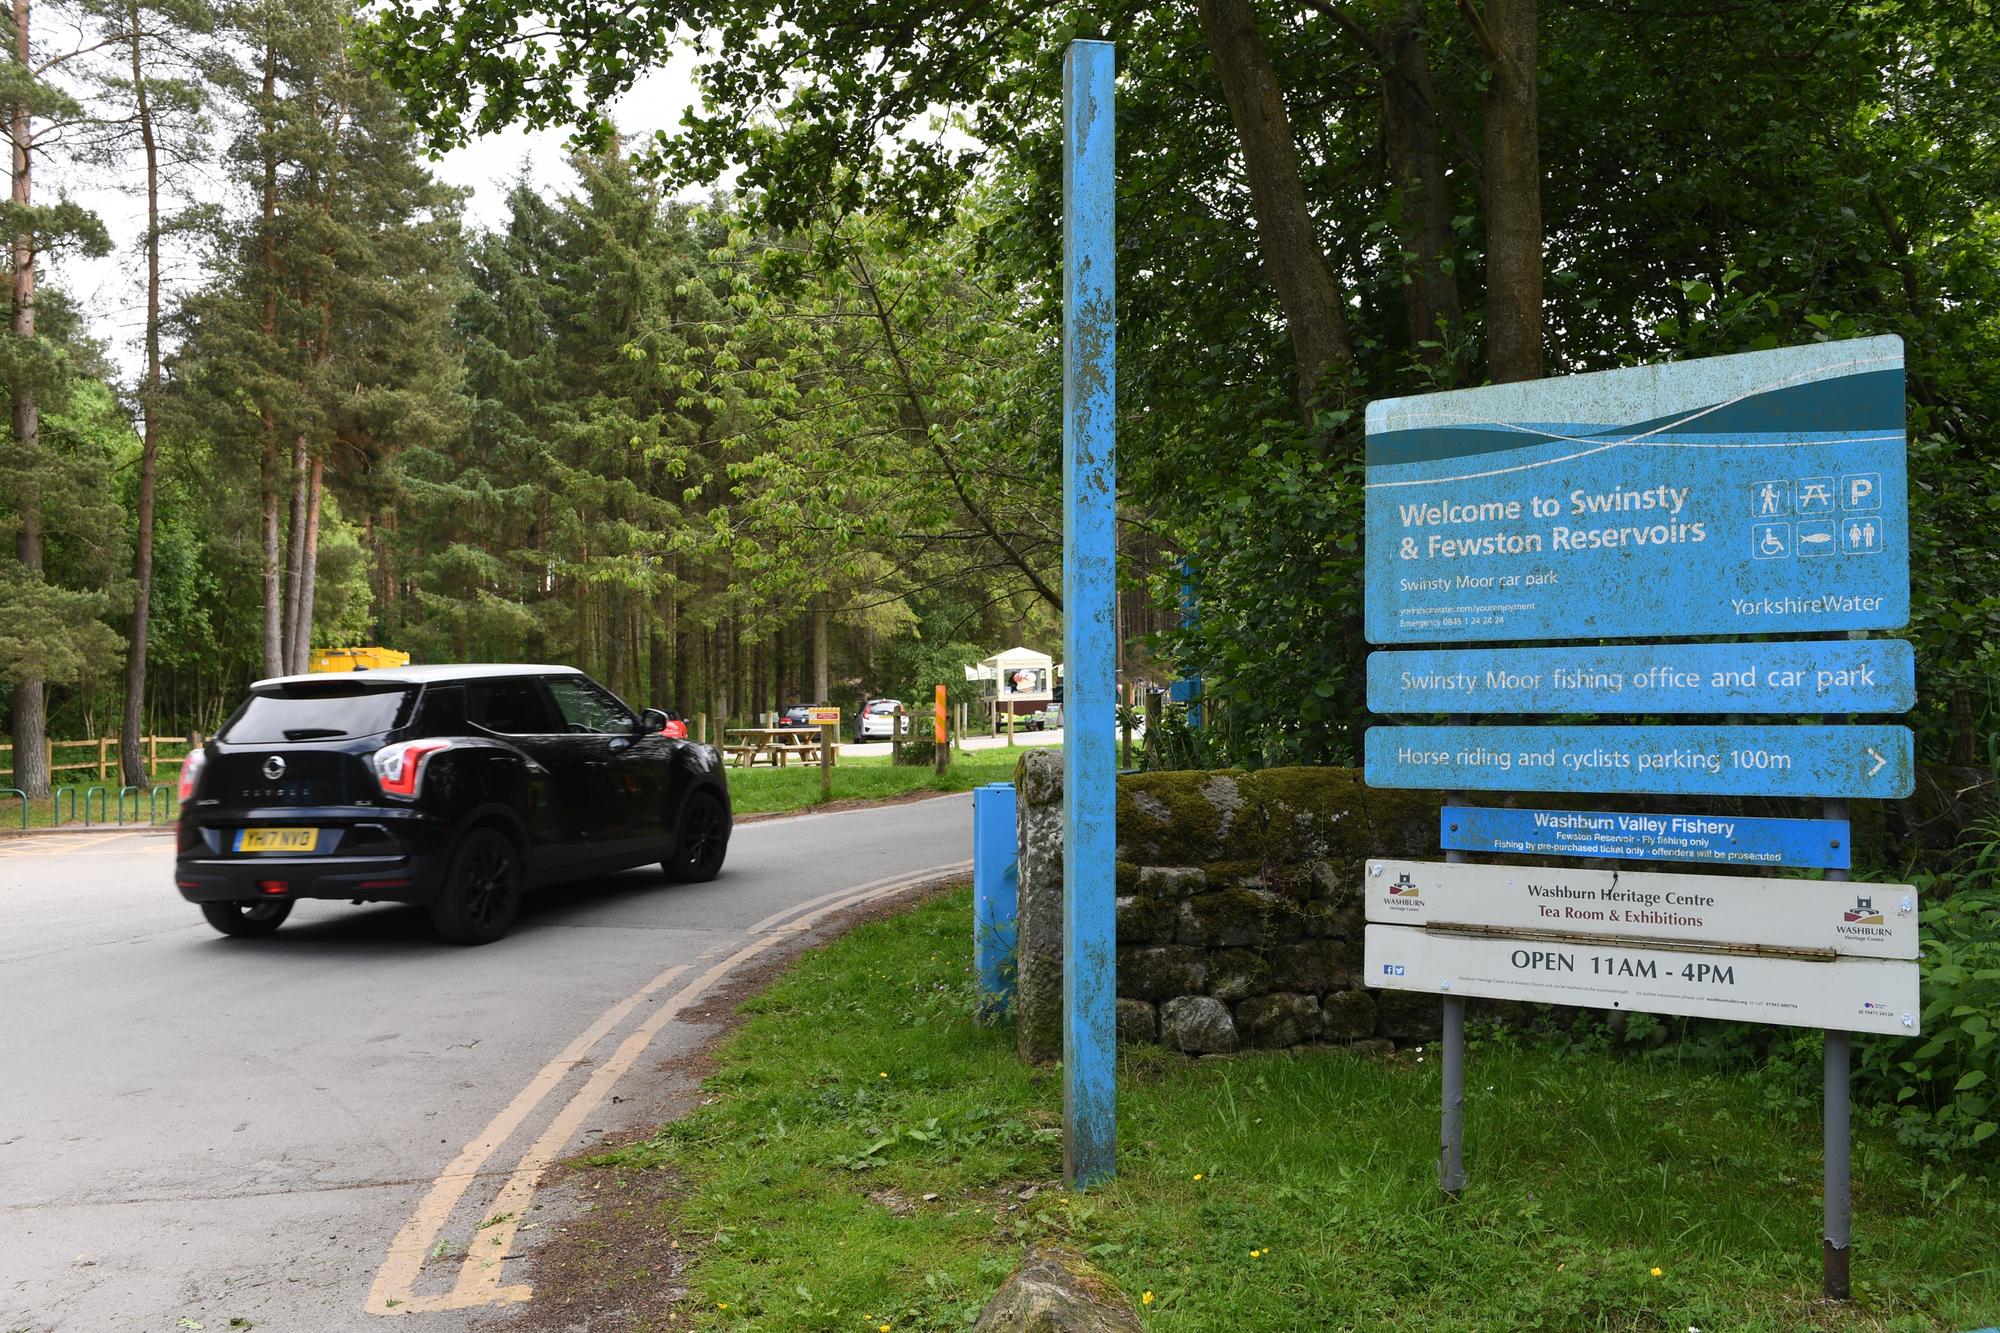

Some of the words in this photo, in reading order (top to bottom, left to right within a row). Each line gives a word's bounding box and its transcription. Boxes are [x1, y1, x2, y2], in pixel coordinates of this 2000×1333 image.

[1851, 479, 1872, 506] P
[1399, 499, 1521, 527] Welcome
[1531, 496, 1561, 519] to
[1570, 485, 1689, 515] Swinsty
[1400, 536, 1419, 560] &
[1428, 531, 1542, 559] Fewston
[1552, 517, 1706, 551] Reservoirs
[1400, 577, 1451, 593] Swinsty
[1455, 575, 1495, 589] Moor
[1499, 575, 1521, 587] car
[1525, 573, 1559, 588] park
[1731, 595, 1884, 616] YorkshireWater
[1400, 619, 1441, 629] Emergency
[1443, 617, 1462, 627] 0845
[1464, 617, 1468, 625] 1
[1471, 617, 1481, 625] 24
[1483, 616, 1493, 625] 24
[1494, 616, 1504, 625] 24
[1400, 671, 1477, 694] Swinsty
[1486, 670, 1543, 689] Moor
[1552, 668, 1623, 693] fishing
[1633, 666, 1700, 688] office
[1711, 666, 1756, 688] and
[1767, 669, 1806, 687] car
[1817, 664, 1875, 692] park
[1398, 747, 1450, 766] Horse
[1456, 747, 1512, 770] riding
[1518, 748, 1555, 767] and
[1562, 748, 1631, 772] cyclists
[1638, 749, 1721, 773] parking
[1730, 750, 1791, 769] 100m
[1534, 813, 1614, 830] Washburn
[1618, 816, 1667, 836] Valley
[1671, 818, 1735, 838] Fishery
[1494, 840, 1524, 851] Fishing
[1525, 841, 1535, 851] by
[1537, 843, 1598, 853] pre-purchased
[1600, 845, 1624, 854] ticket
[1625, 846, 1645, 856] only
[1652, 848, 1694, 858] offenders
[1696, 850, 1712, 858] will
[1714, 850, 1726, 859] be
[1728, 852, 1782, 862] prosecuted
[1556, 831, 1592, 841] Fewston
[1594, 833, 1634, 843] Reservoir
[1642, 835, 1655, 845] Fly
[1657, 836, 1687, 847] fishing
[1689, 838, 1710, 848] only
[1383, 898, 1425, 907] WASHBURN
[1527, 884, 1596, 900] Washburn
[1601, 888, 1661, 907] Heritage
[1665, 892, 1715, 907] Centre
[1538, 905, 1560, 918] Tea
[1565, 906, 1604, 921] Room
[1609, 909, 1621, 922] &
[1624, 910, 1704, 928] Exhibitions
[1836, 925, 1892, 936] WASHBURN
[1511, 949, 1575, 973] OPEN
[1590, 956, 1658, 979] 11AM
[1681, 963, 1735, 985] 4PM
